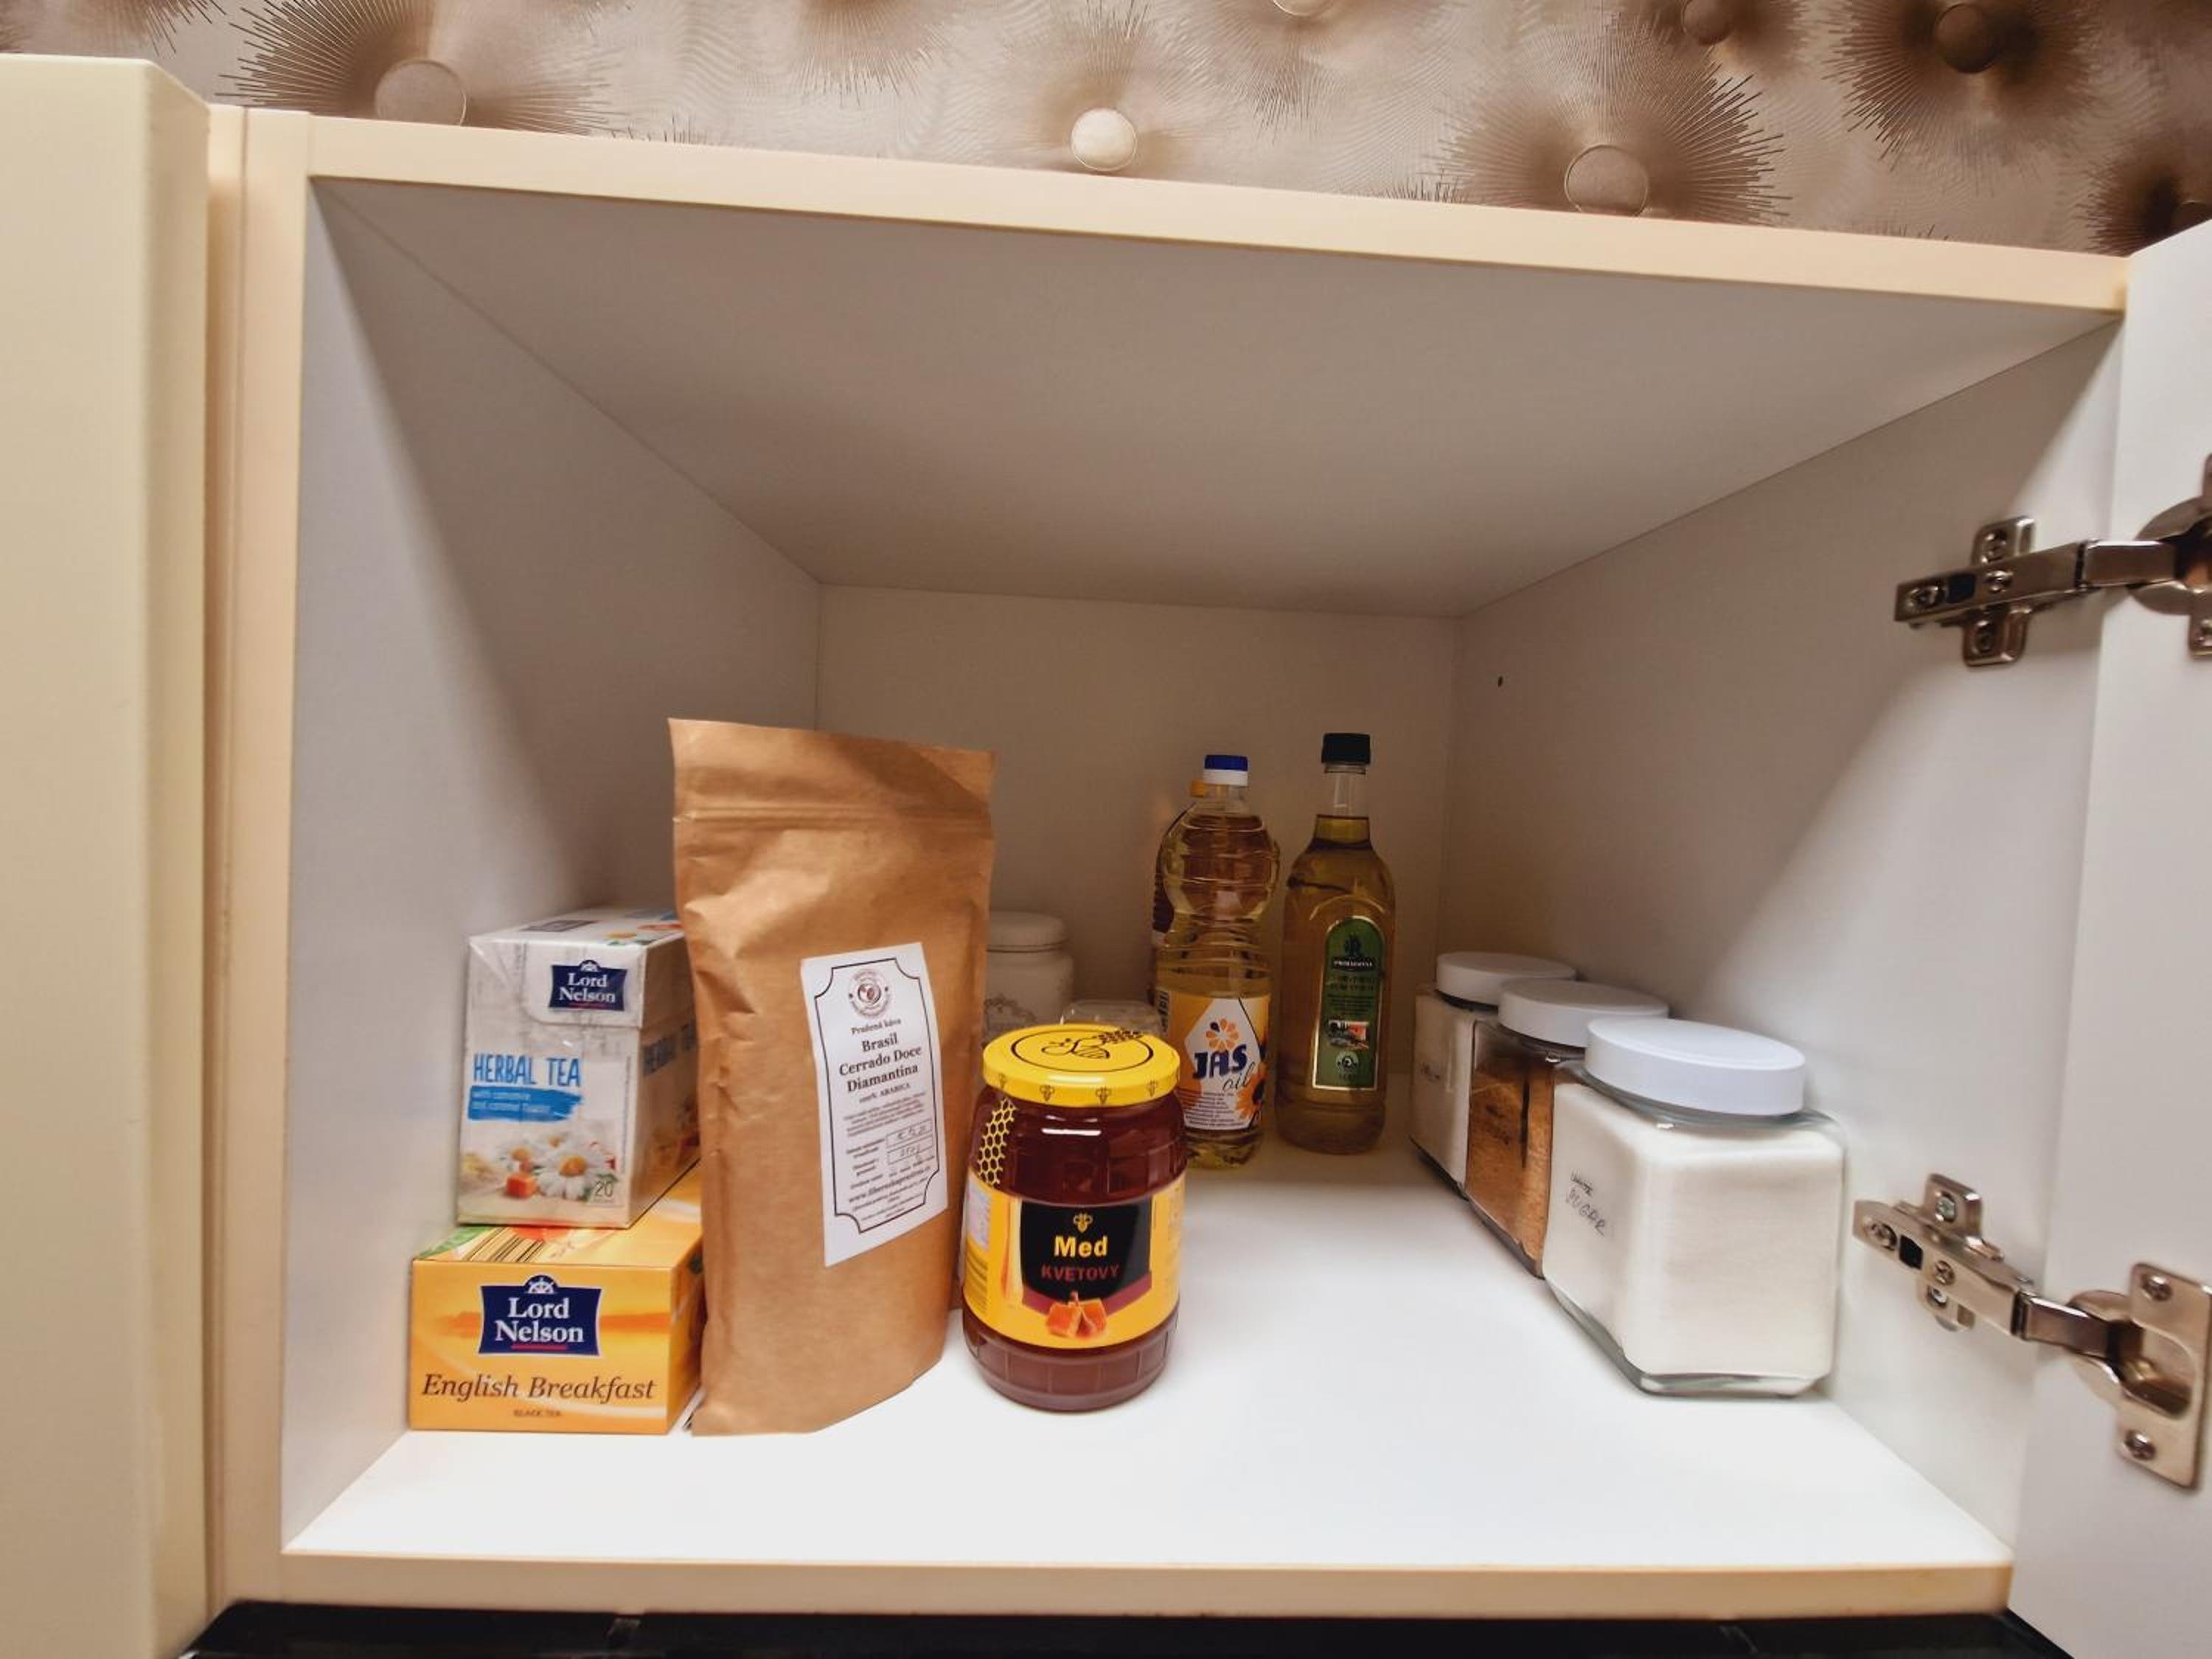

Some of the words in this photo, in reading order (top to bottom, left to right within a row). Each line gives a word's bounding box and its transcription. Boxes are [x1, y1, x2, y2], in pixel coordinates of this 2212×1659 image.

[567, 973, 608, 987] Lord
[559, 987, 616, 1003] Nelson
[861, 1032, 897, 1051] Brasil
[473, 1054, 538, 1085] HERBAL
[546, 1057, 580, 1088] TEA
[839, 1054, 890, 1076] Cerrado
[894, 1047, 922, 1062] Doce
[1192, 1044, 1247, 1079] JAS
[847, 1065, 918, 1092] Diamantina
[1222, 1062, 1256, 1092] oil
[594, 1180, 613, 1198] 20
[1054, 1236, 1107, 1257] Med
[507, 1297, 569, 1319] Lord
[495, 1320, 584, 1343] Nelson
[422, 1373, 518, 1402] English
[529, 1376, 657, 1404] Breakfast
